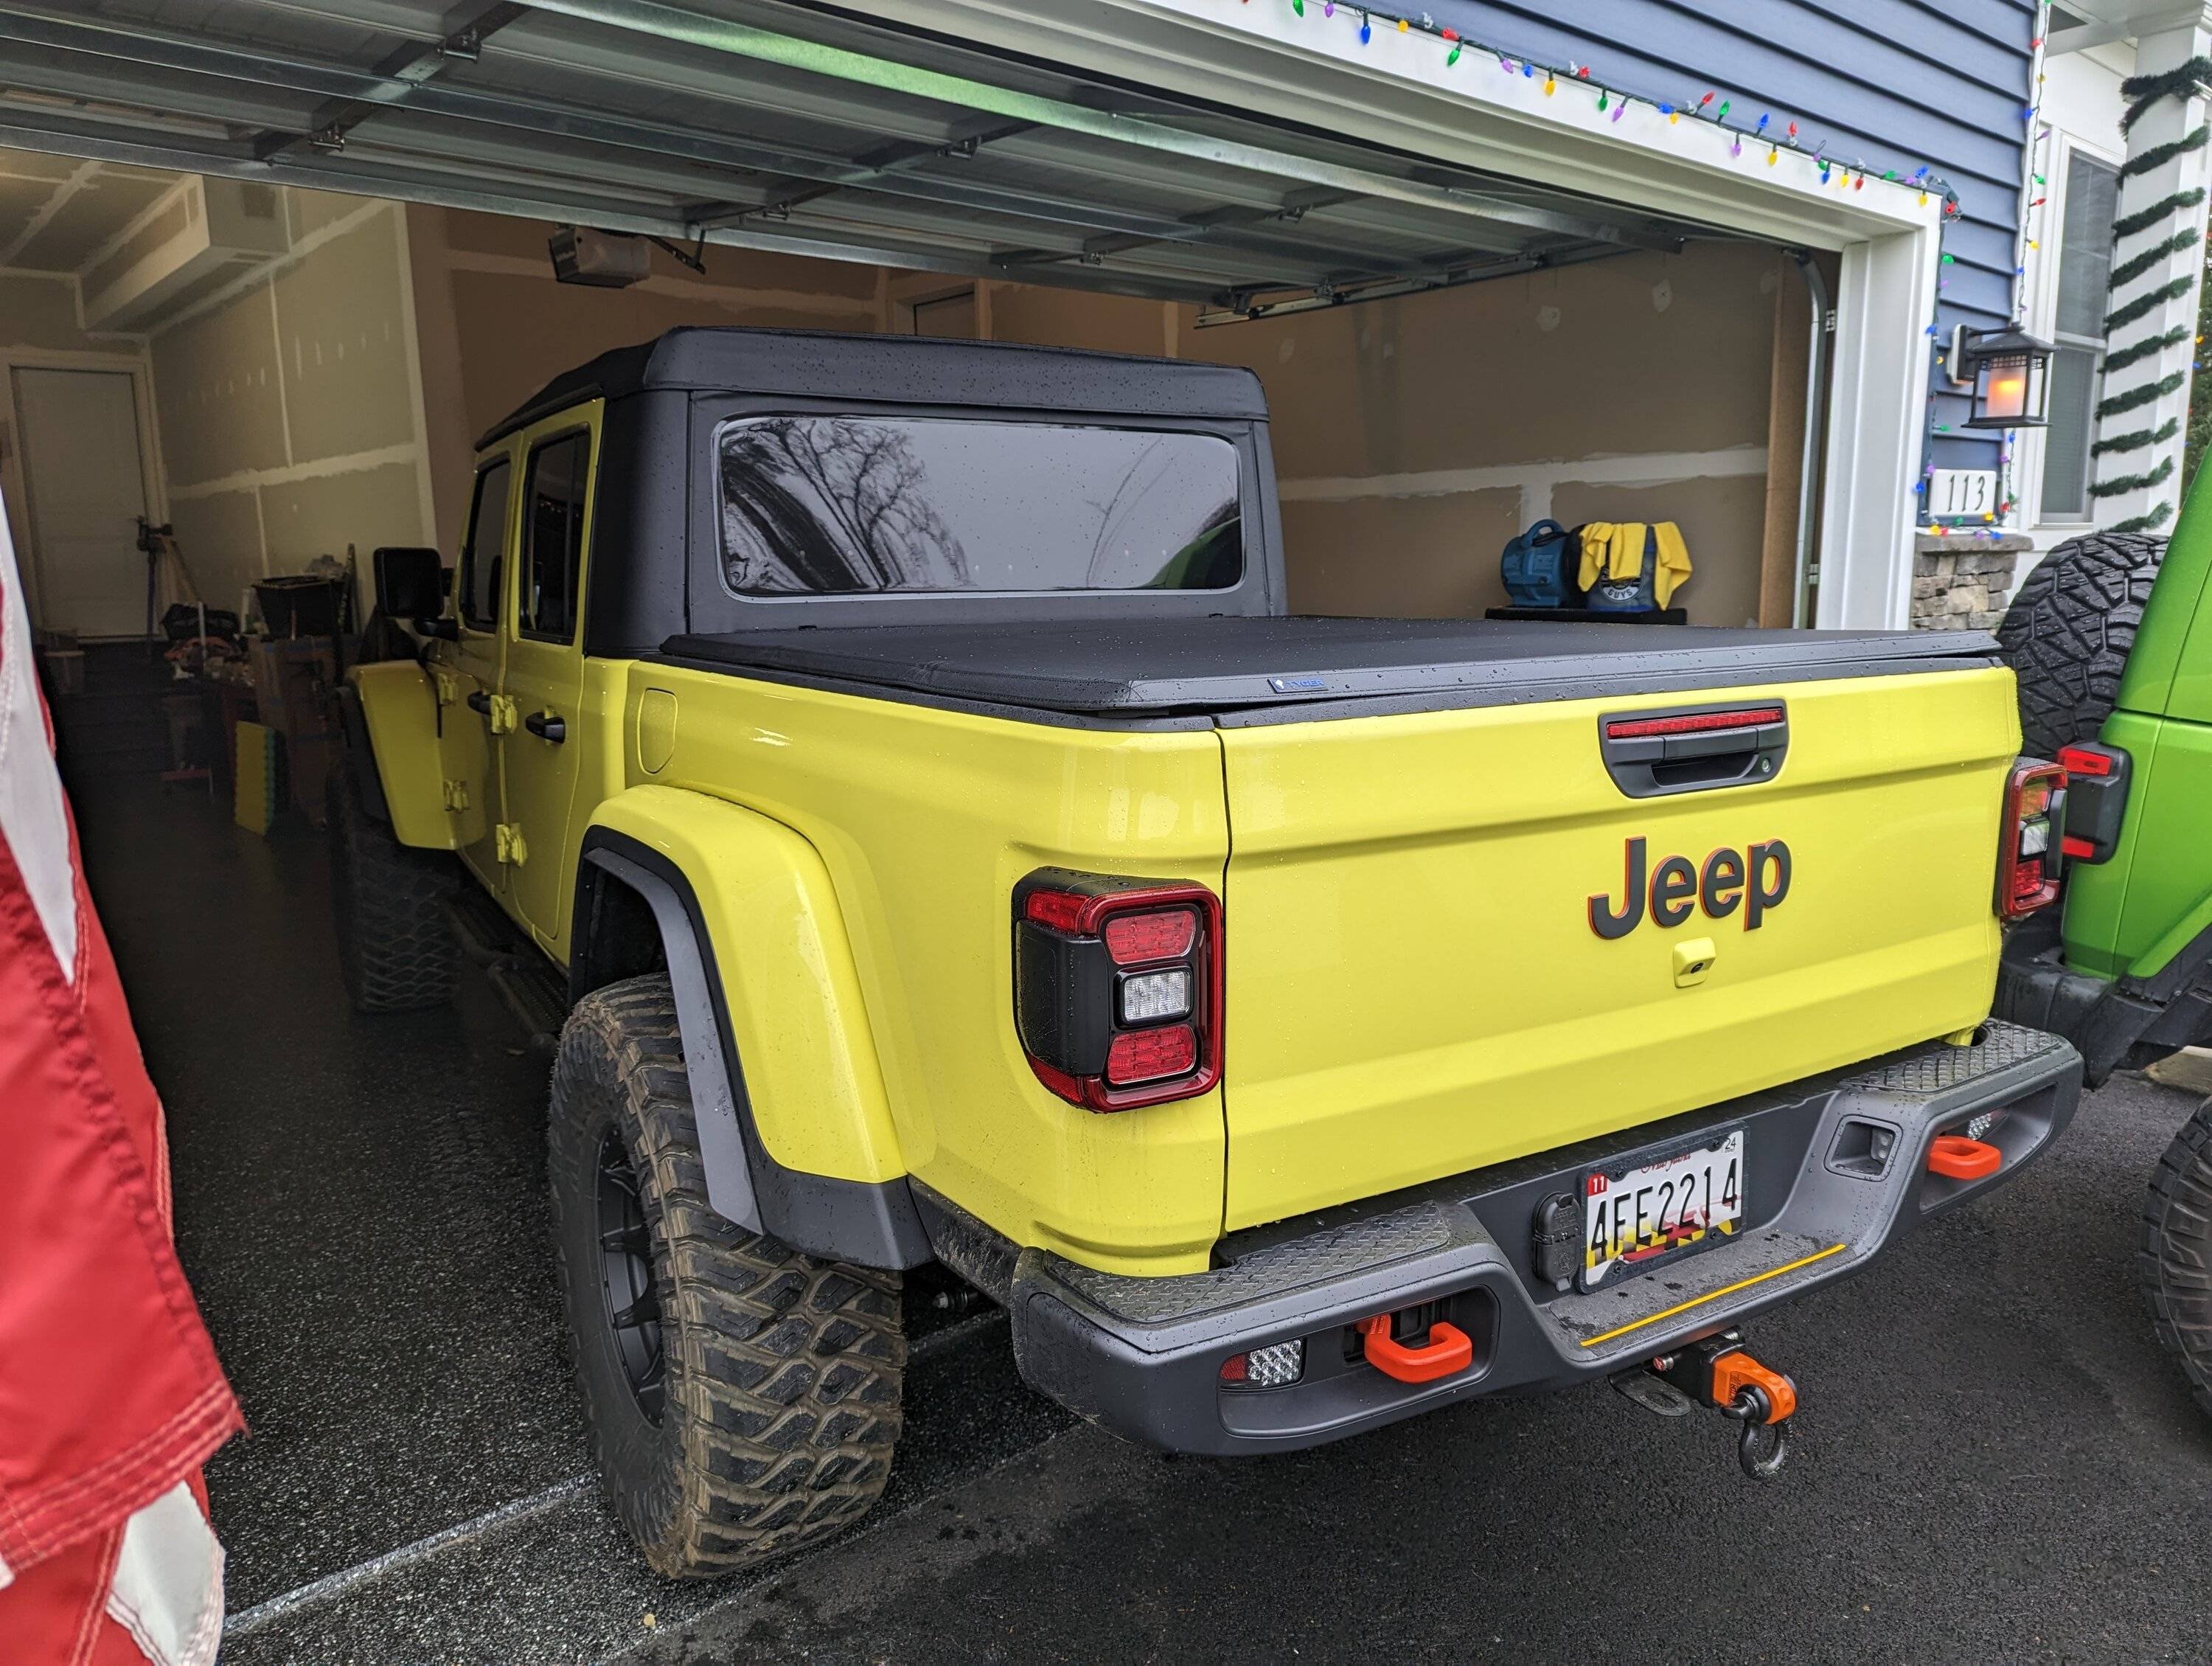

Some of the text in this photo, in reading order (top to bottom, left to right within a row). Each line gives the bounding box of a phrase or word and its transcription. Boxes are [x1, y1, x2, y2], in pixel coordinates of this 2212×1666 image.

[1947, 474, 1985, 512] 113
[1607, 589, 1632, 599] GUYS
[1286, 678, 1325, 687] TYGER
[1587, 835, 1792, 940] Jeep
[1725, 1136, 1736, 1150] 24
[1593, 1176, 1605, 1193] 11
[1590, 1158, 1737, 1257] 4FE2214
